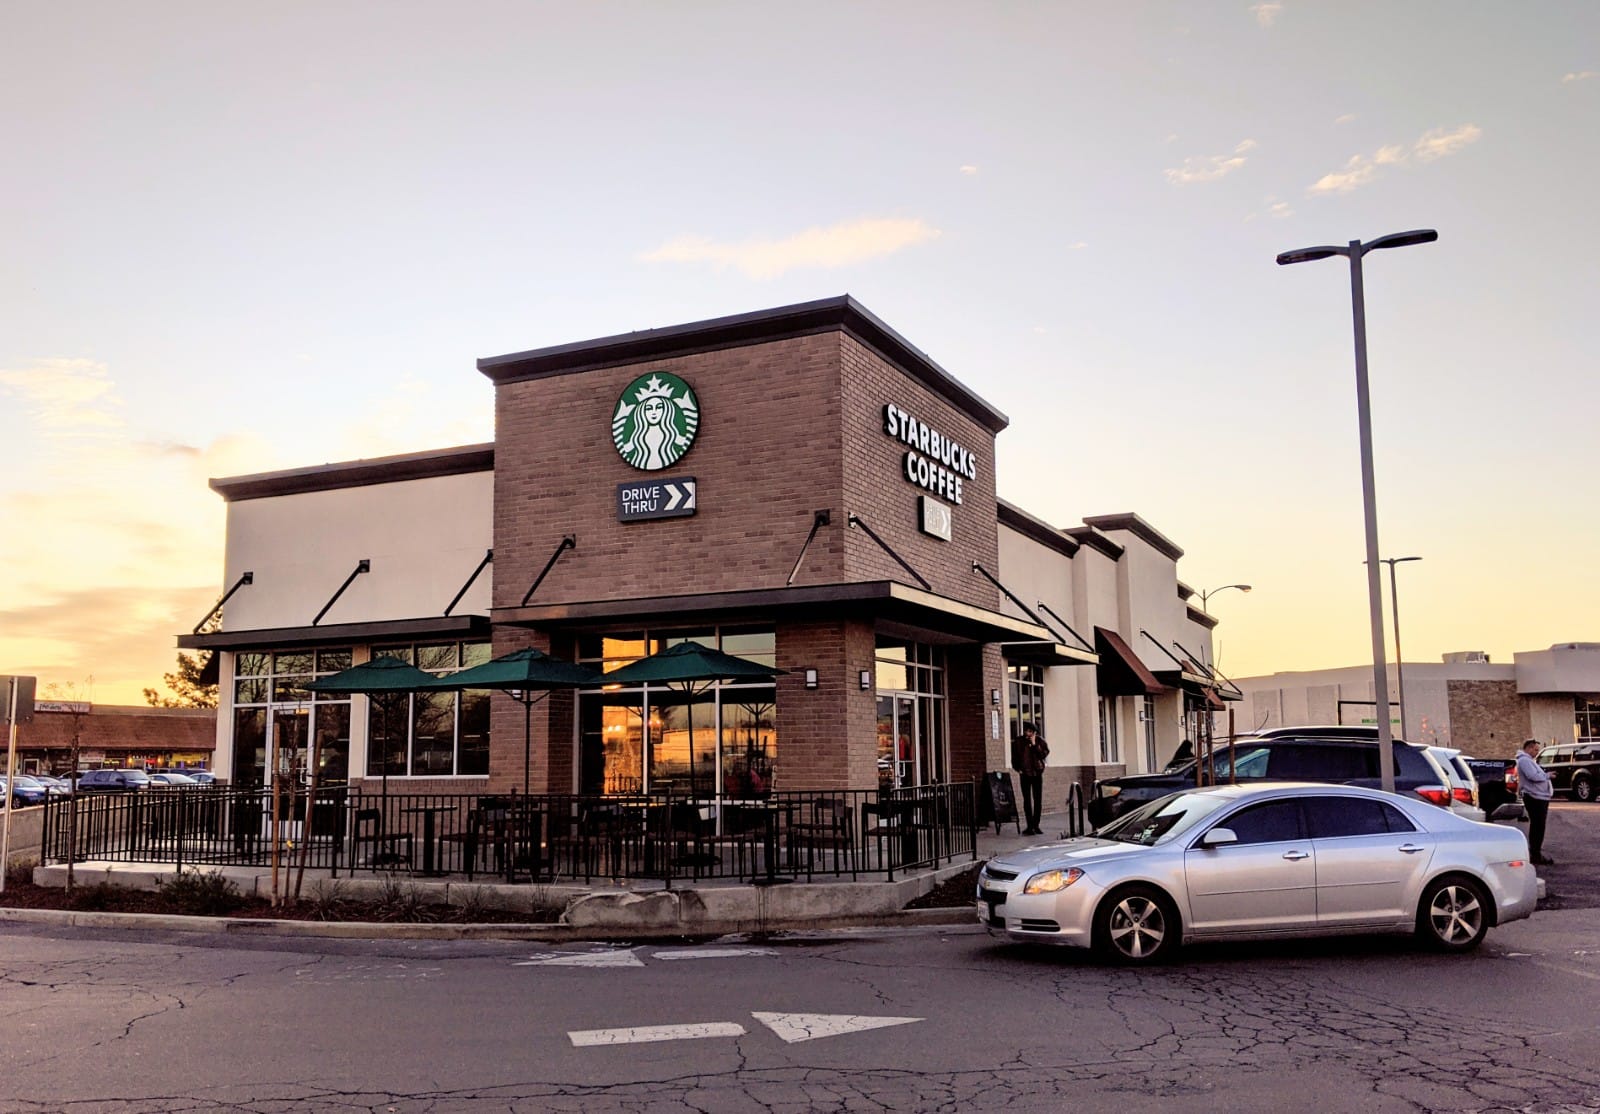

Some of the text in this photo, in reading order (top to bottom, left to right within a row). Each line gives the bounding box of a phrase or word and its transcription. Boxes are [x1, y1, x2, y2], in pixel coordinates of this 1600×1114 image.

[886, 403, 977, 481] STARBUCKS
[622, 486, 660, 501] DRIVE
[906, 451, 963, 505] COFFEE
[622, 499, 657, 514] THRU
